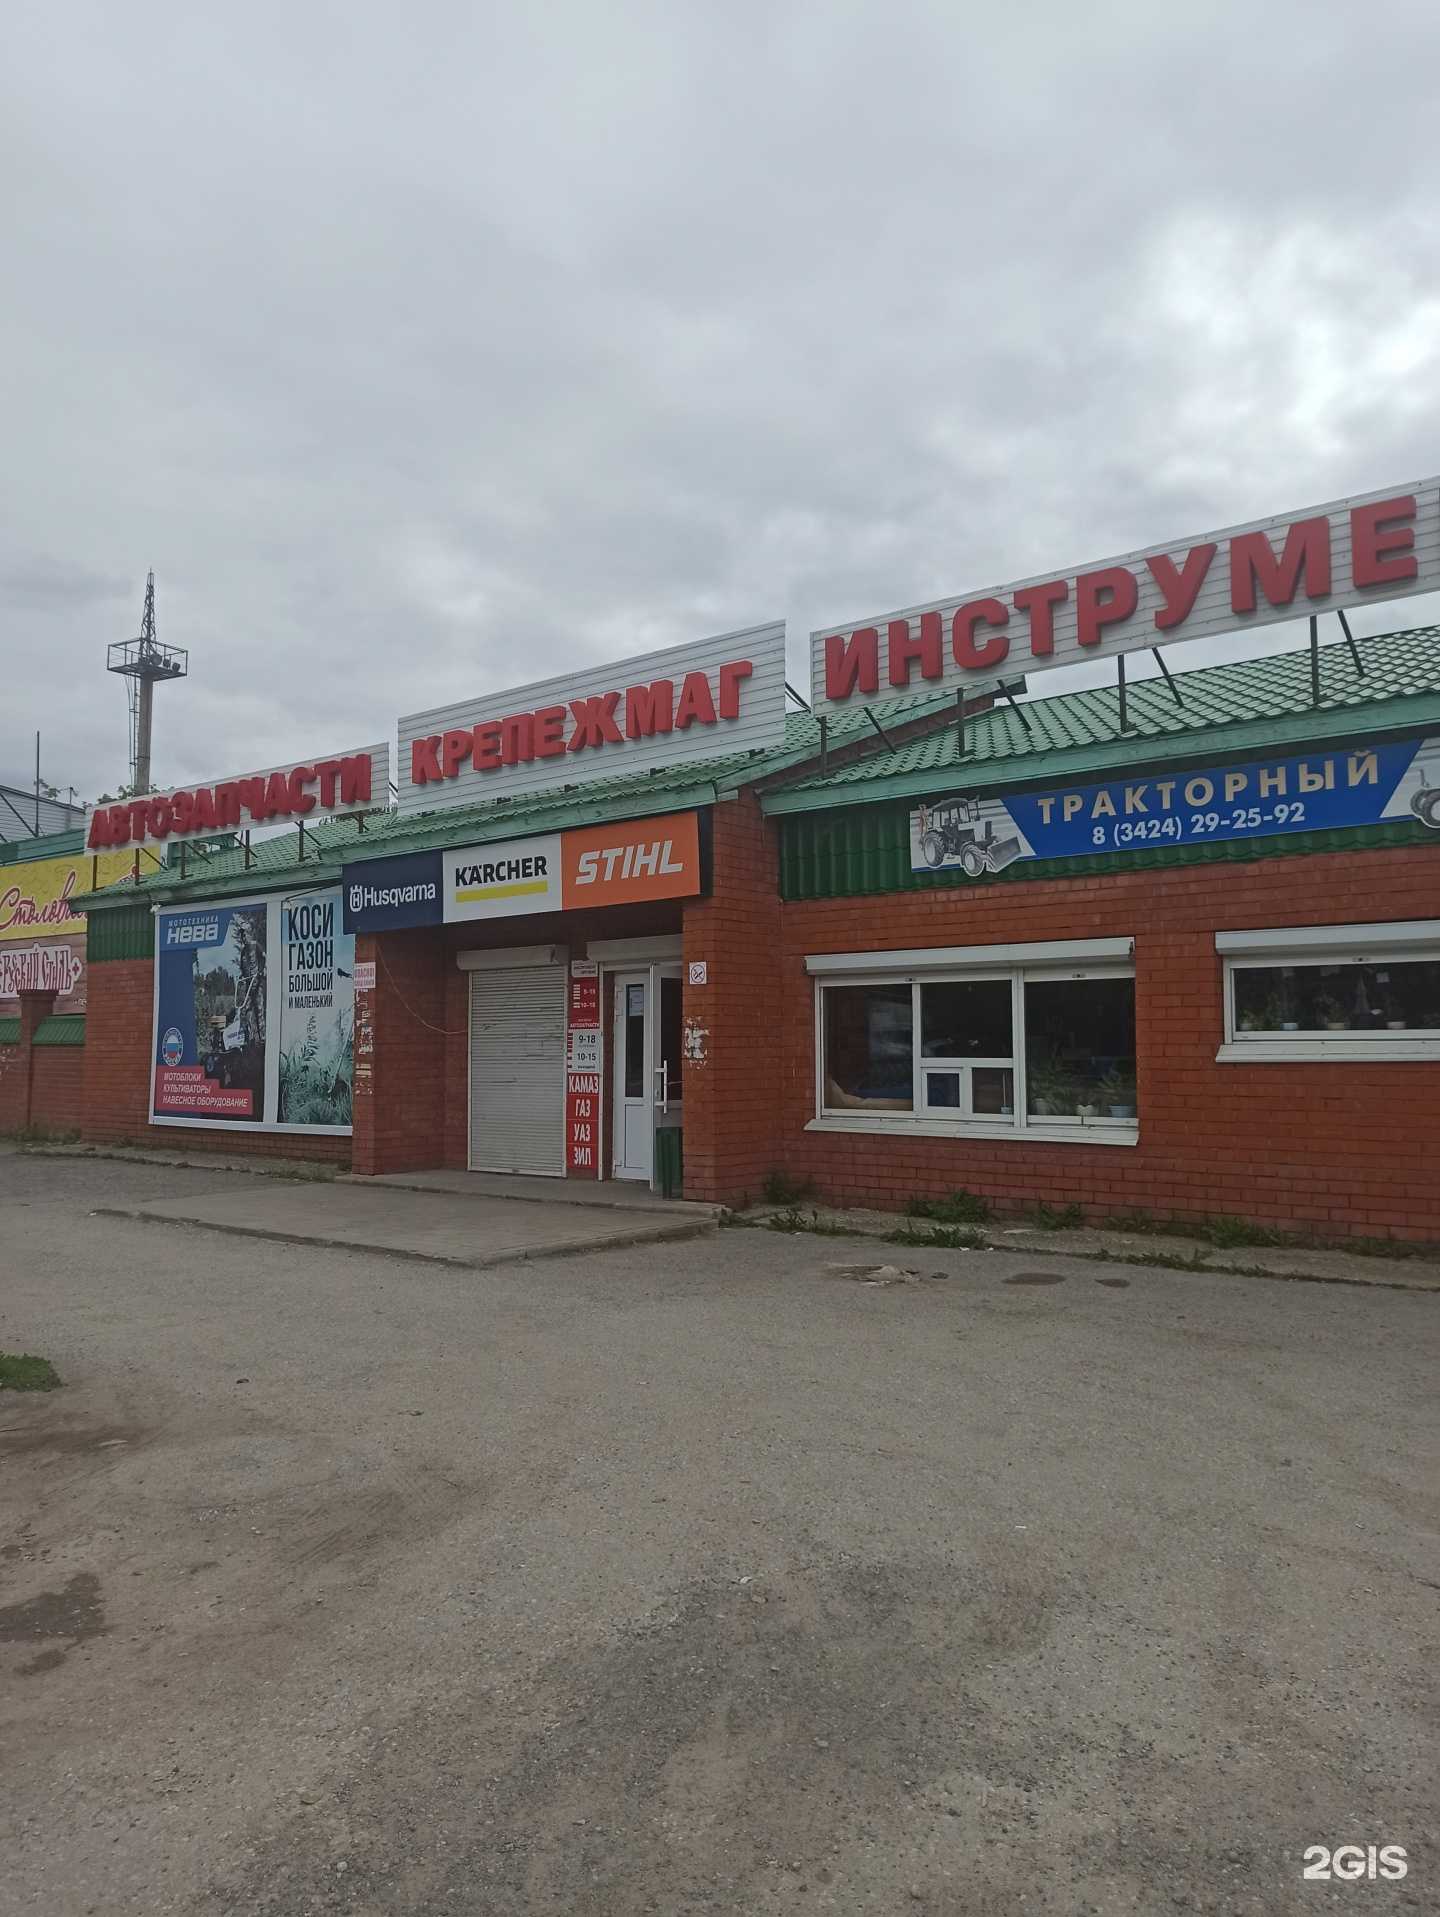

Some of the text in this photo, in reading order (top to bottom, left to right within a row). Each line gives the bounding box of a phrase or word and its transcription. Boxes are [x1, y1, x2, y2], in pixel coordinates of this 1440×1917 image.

[825, 495, 1418, 701] ИНСТРУМЕ
[411, 660, 753, 785] КРЕПЕЖМАГ
[1037, 750, 1378, 825] ТРАКТОРНЫЙ
[87, 754, 372, 848] АВТОЗАПЧАСТИ
[1091, 802, 1306, 847] 8 (3424) 29-25-92
[455, 855, 548, 887] KÄRCHER
[575, 840, 684, 885] STIHL
[363, 882, 436, 907] Husqvarna
[168, 916, 218, 927] МОТОТЕХНИКА
[288, 902, 334, 941] КОСИ
[288, 940, 334, 970] ГАЗОН
[288, 969, 333, 992] БОЛЬШОЙ
[288, 992, 333, 1009] И МАЛЕНЬКИЙ
[578, 1034, 596, 1044] 9-18
[577, 1052, 597, 1061] 10-15
[164, 1072, 202, 1081] МОТОБЛОКИ
[568, 1075, 599, 1094] КАМАЗ
[163, 1084, 211, 1094] КУЛЬТИВАТОРЫ
[162, 1095, 248, 1108] НАВЕСНОЕ ОБОРУДОВАНИЕ
[575, 1098, 591, 1117] ГАЗ
[573, 1123, 591, 1142] УАЗ
[573, 1147, 592, 1166] ЗИЛ
